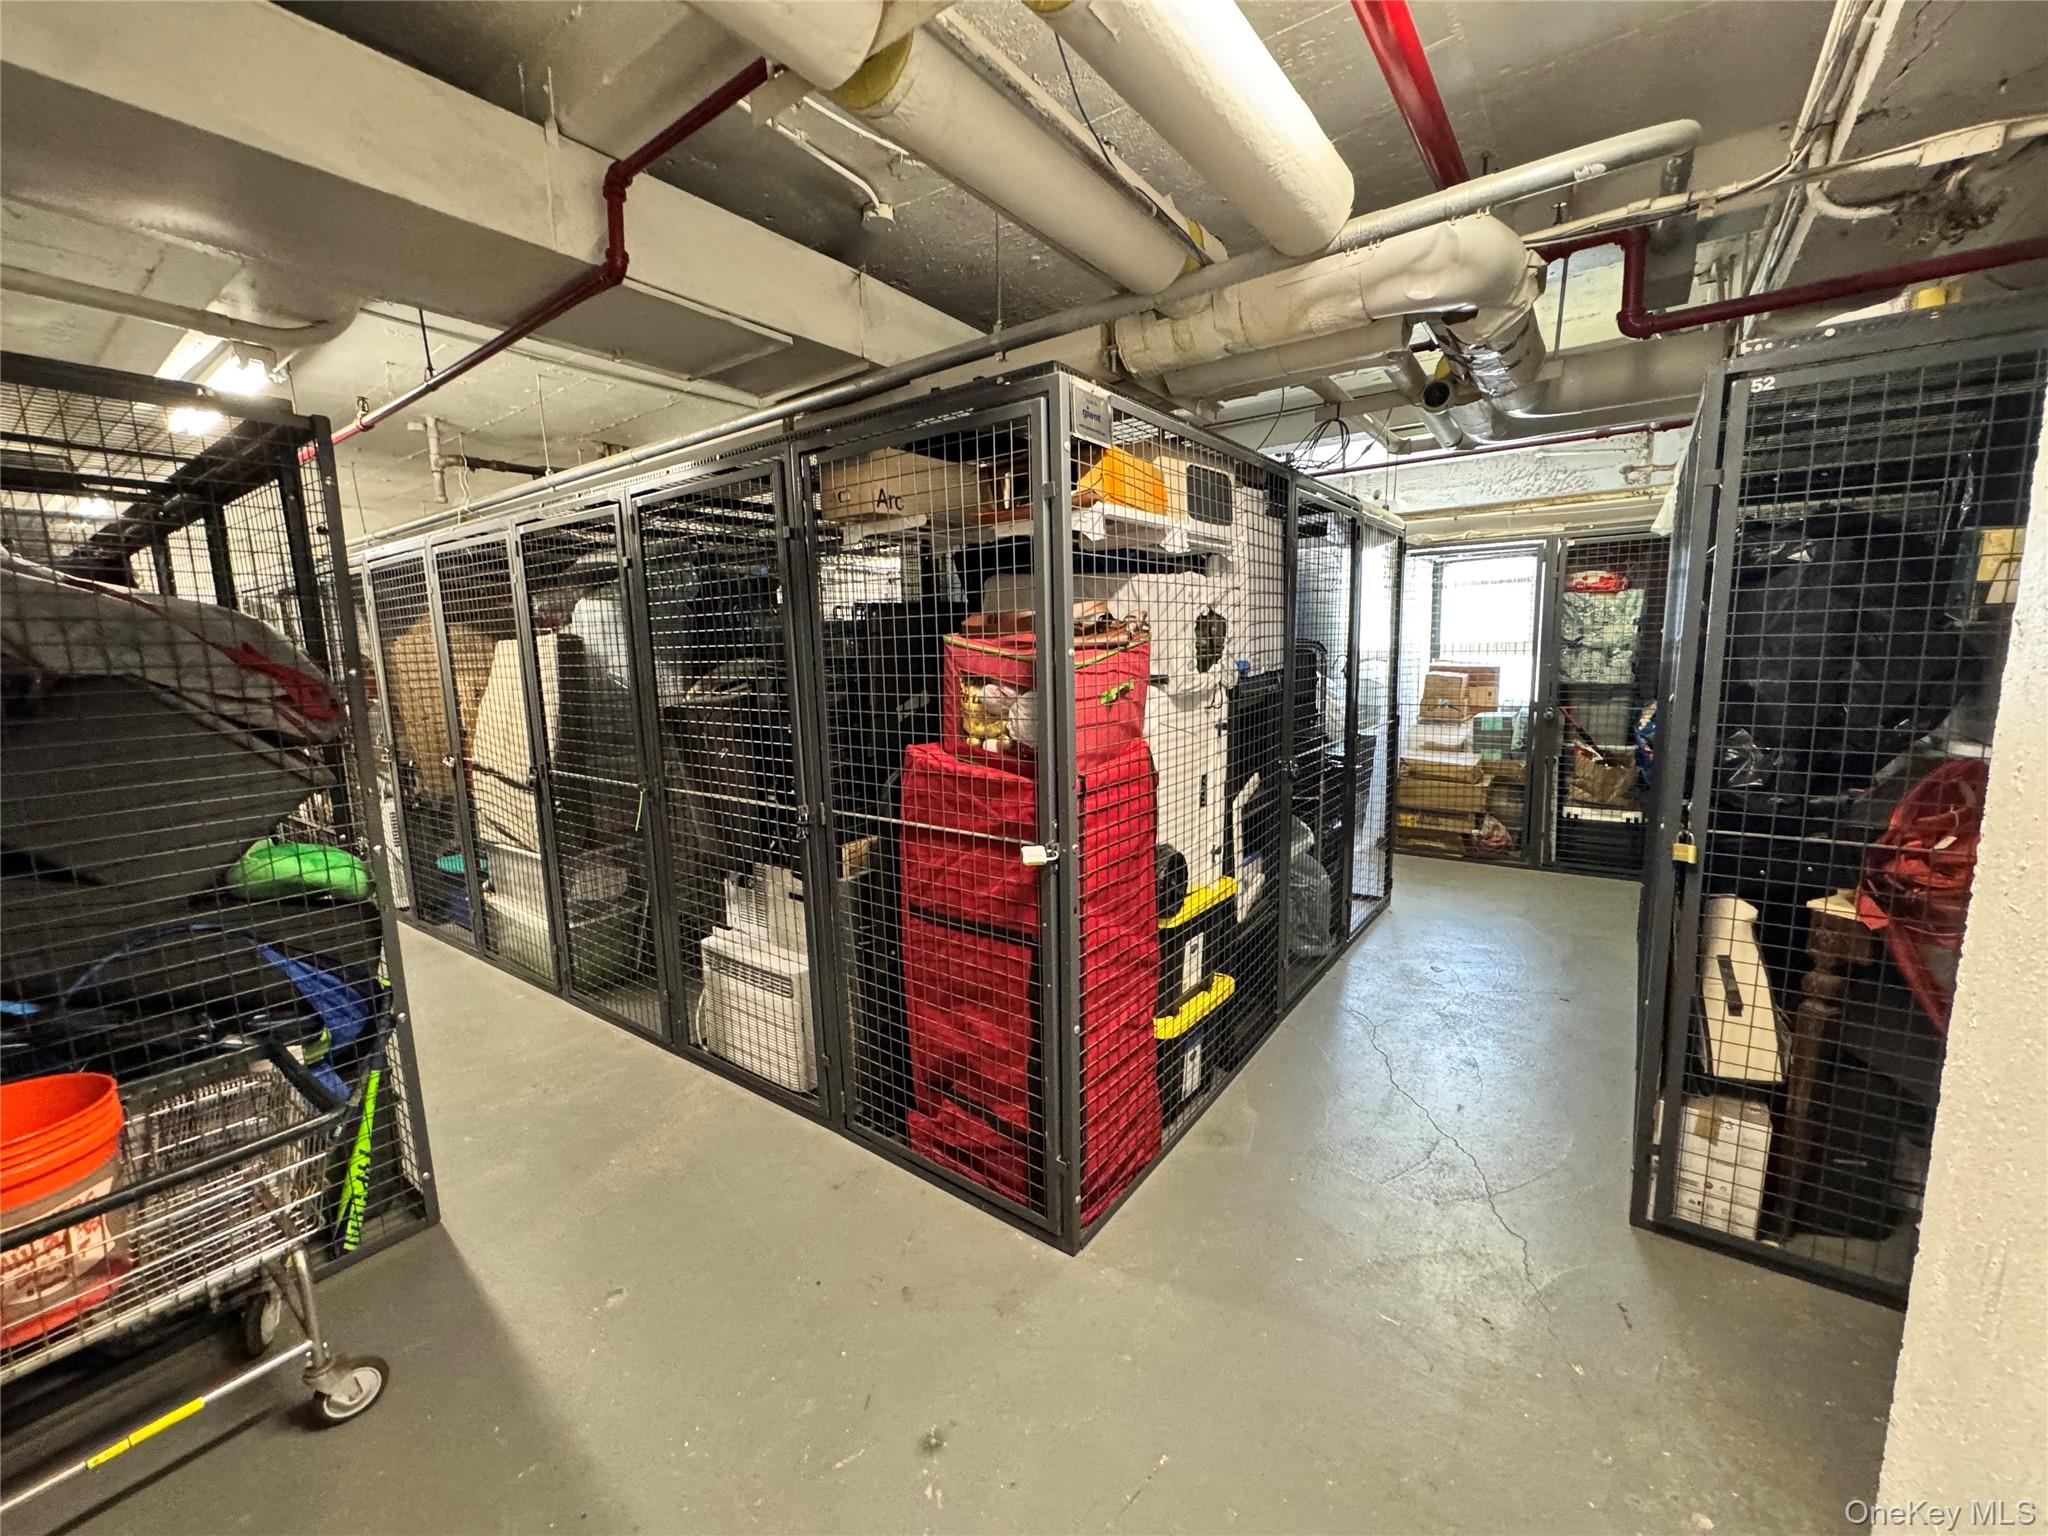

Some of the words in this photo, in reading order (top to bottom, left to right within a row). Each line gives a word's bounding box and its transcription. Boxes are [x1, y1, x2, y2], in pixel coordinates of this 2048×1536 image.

[1751, 376, 1776, 393] 52
[809, 455, 818, 466] 16
[877, 489, 904, 511] Arc
